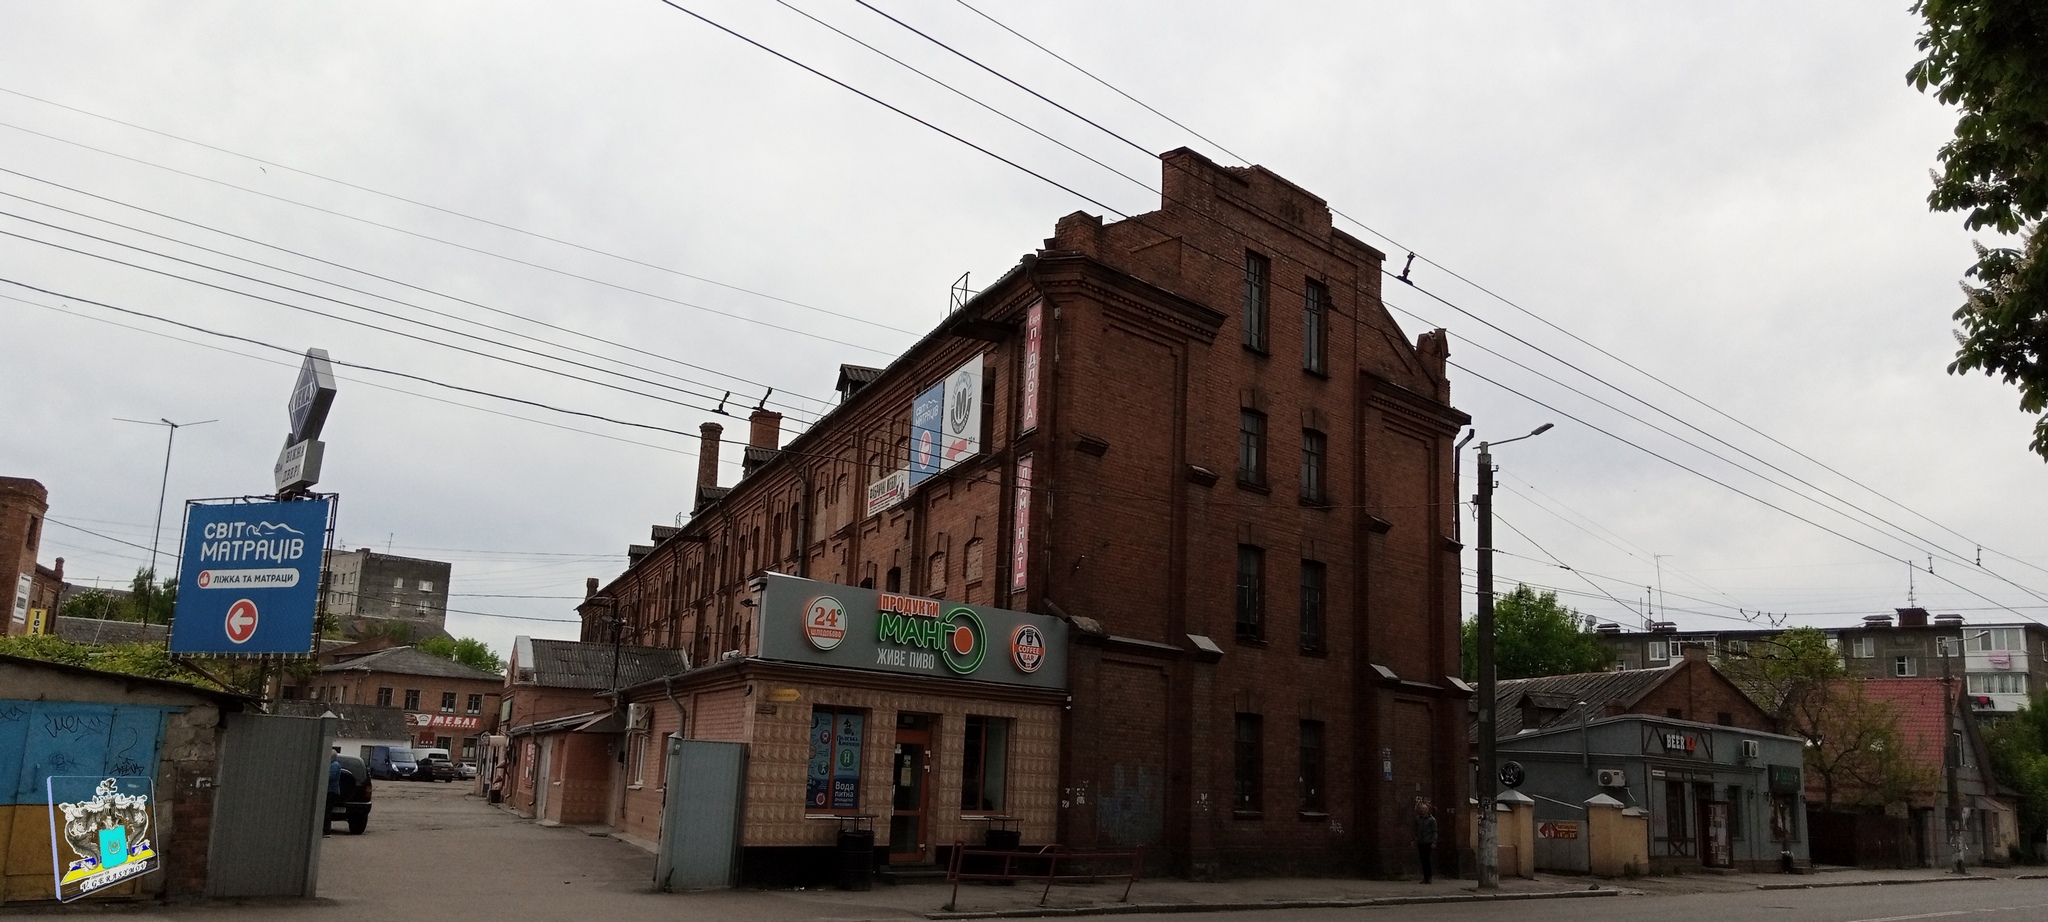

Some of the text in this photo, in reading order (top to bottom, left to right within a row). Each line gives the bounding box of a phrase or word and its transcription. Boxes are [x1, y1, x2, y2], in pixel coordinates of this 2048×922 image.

[1026, 327, 1037, 420] ПІДЛОГА
[1018, 467, 1028, 569] ЛАМІНАТ
[204, 521, 246, 539] СВІТ
[200, 538, 305, 563] МАТРАЦІВ
[213, 573, 294, 583] ЛІЖКА ТА МАТРАЦИ
[879, 594, 940, 618] ПРОДУКТИ
[879, 607, 988, 675] МАНГО
[1018, 645, 1040, 654] COFFEE
[877, 648, 935, 669] ЖИВЕ ПИВО
[433, 715, 477, 726] МЕБЛІ
[835, 781, 855, 791] Вода
